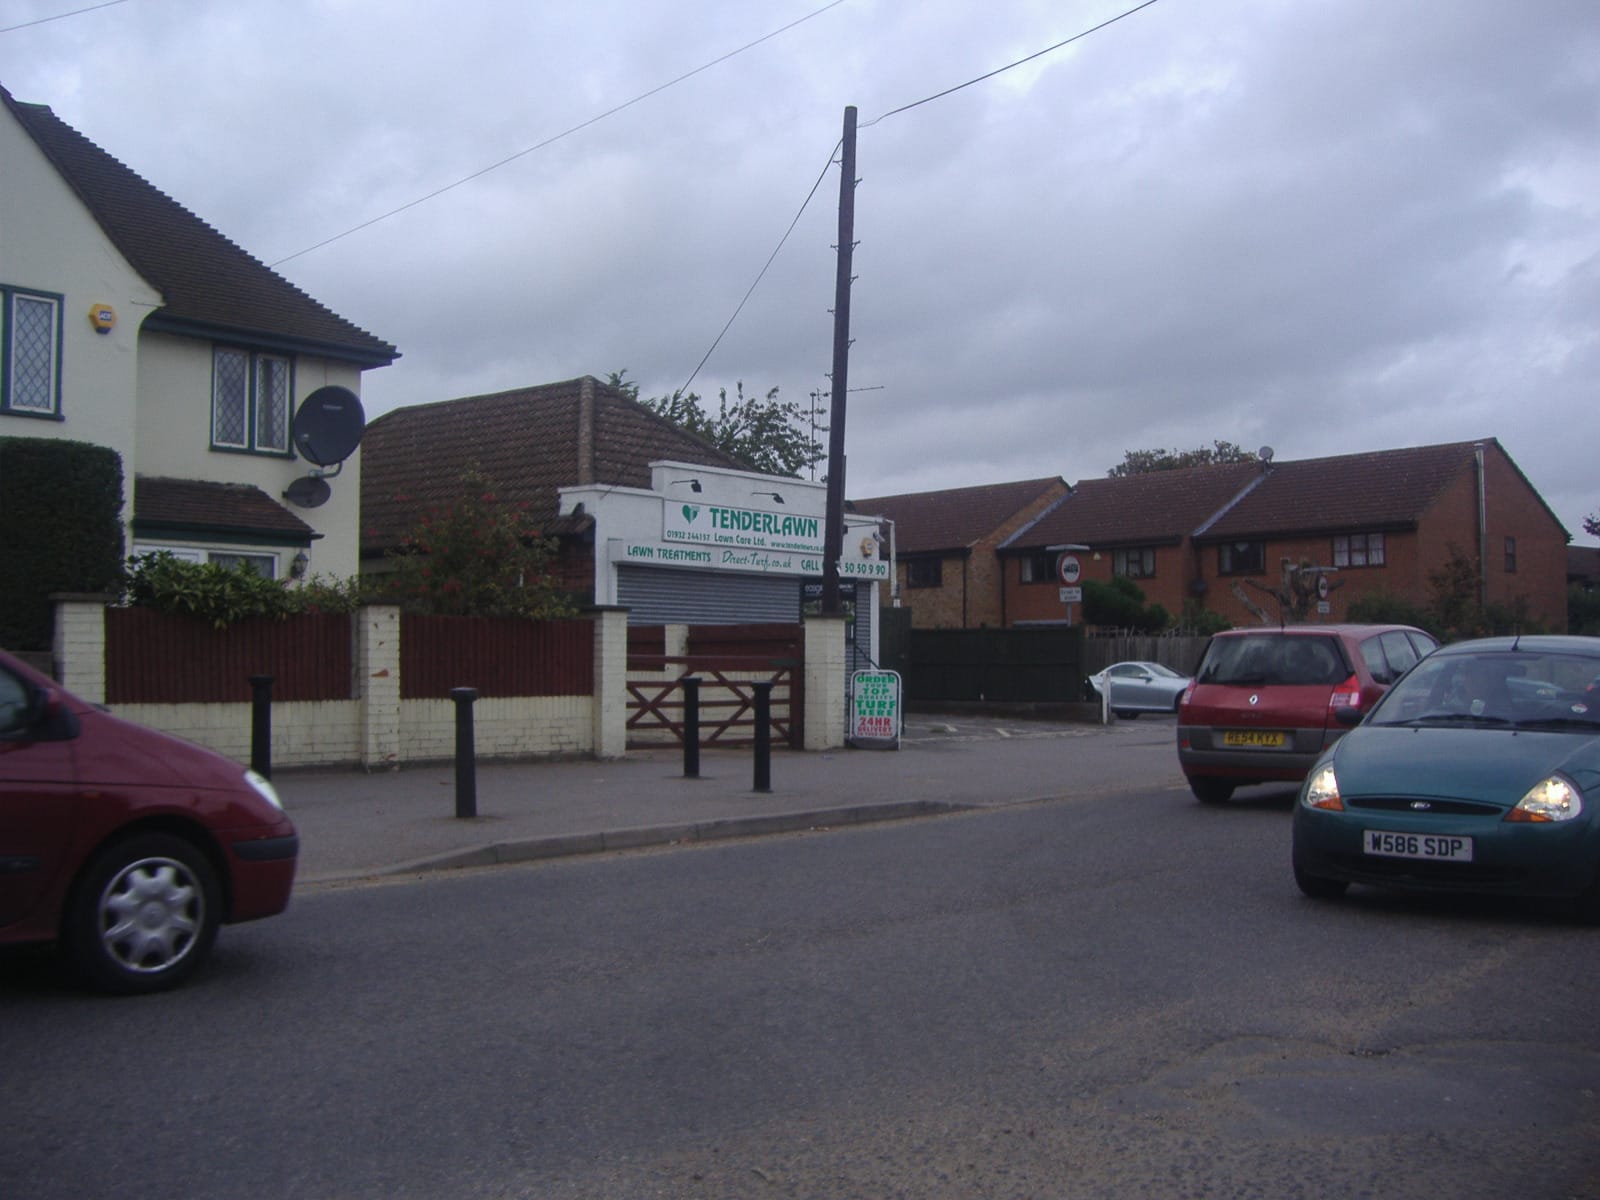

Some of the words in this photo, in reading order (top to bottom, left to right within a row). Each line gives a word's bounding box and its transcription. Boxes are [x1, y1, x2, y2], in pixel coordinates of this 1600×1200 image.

[709, 507, 818, 538] TENDERLAWN
[714, 533, 733, 545] Lawn
[736, 535, 751, 546] Care
[753, 536, 766, 547] Ltd.
[627, 545, 653, 558] LAWN
[657, 548, 711, 562] TREATMENTS
[801, 559, 819, 571] CALL
[845, 562, 855, 573] 50
[857, 563, 867, 574] 50
[875, 564, 886, 576] 90
[856, 700, 896, 708] TURF
[860, 717, 891, 726] 24HR
[1371, 832, 1419, 855] W586
[1424, 837, 1463, 857] SDP
